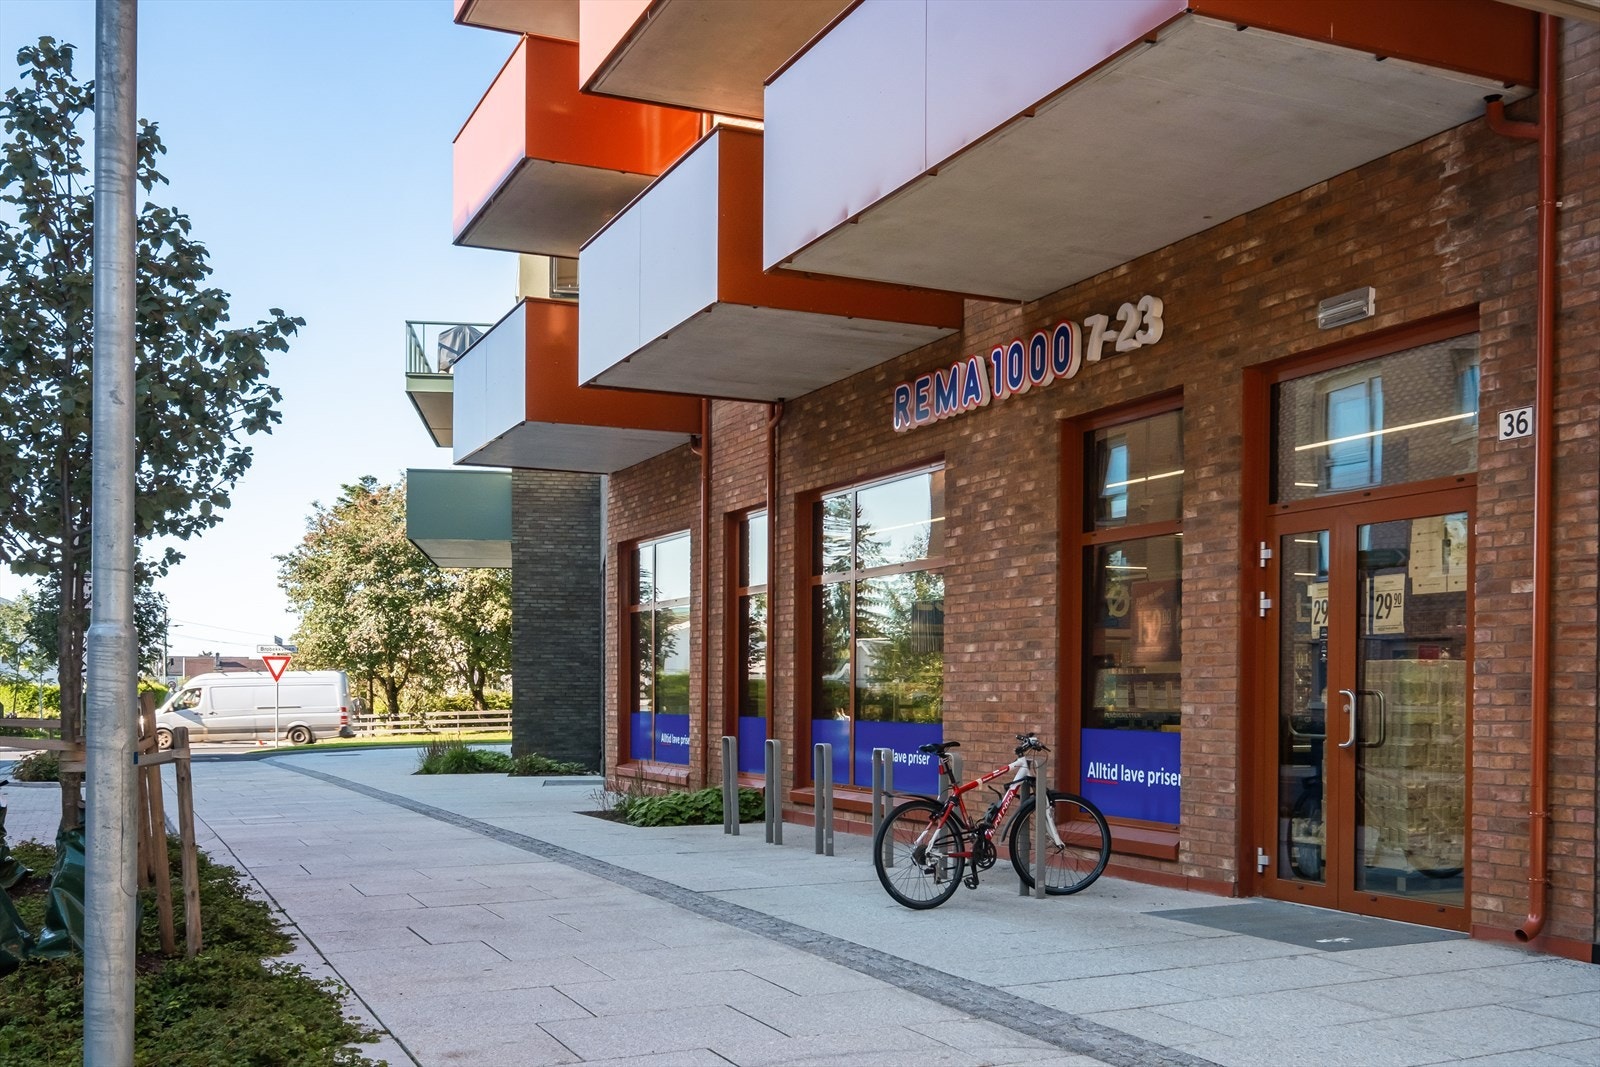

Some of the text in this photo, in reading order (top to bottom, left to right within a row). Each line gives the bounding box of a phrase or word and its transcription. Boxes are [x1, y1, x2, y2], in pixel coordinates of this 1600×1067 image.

[1084, 295, 1163, 361] 7-23
[894, 320, 1080, 432] REMA 1000
[1504, 411, 1528, 437] 36
[1313, 599, 1328, 625] 29
[1375, 593, 1392, 620] 29
[680, 734, 690, 746] prise
[908, 750, 930, 766] priser
[1087, 762, 1181, 787] Alltid lave priser
